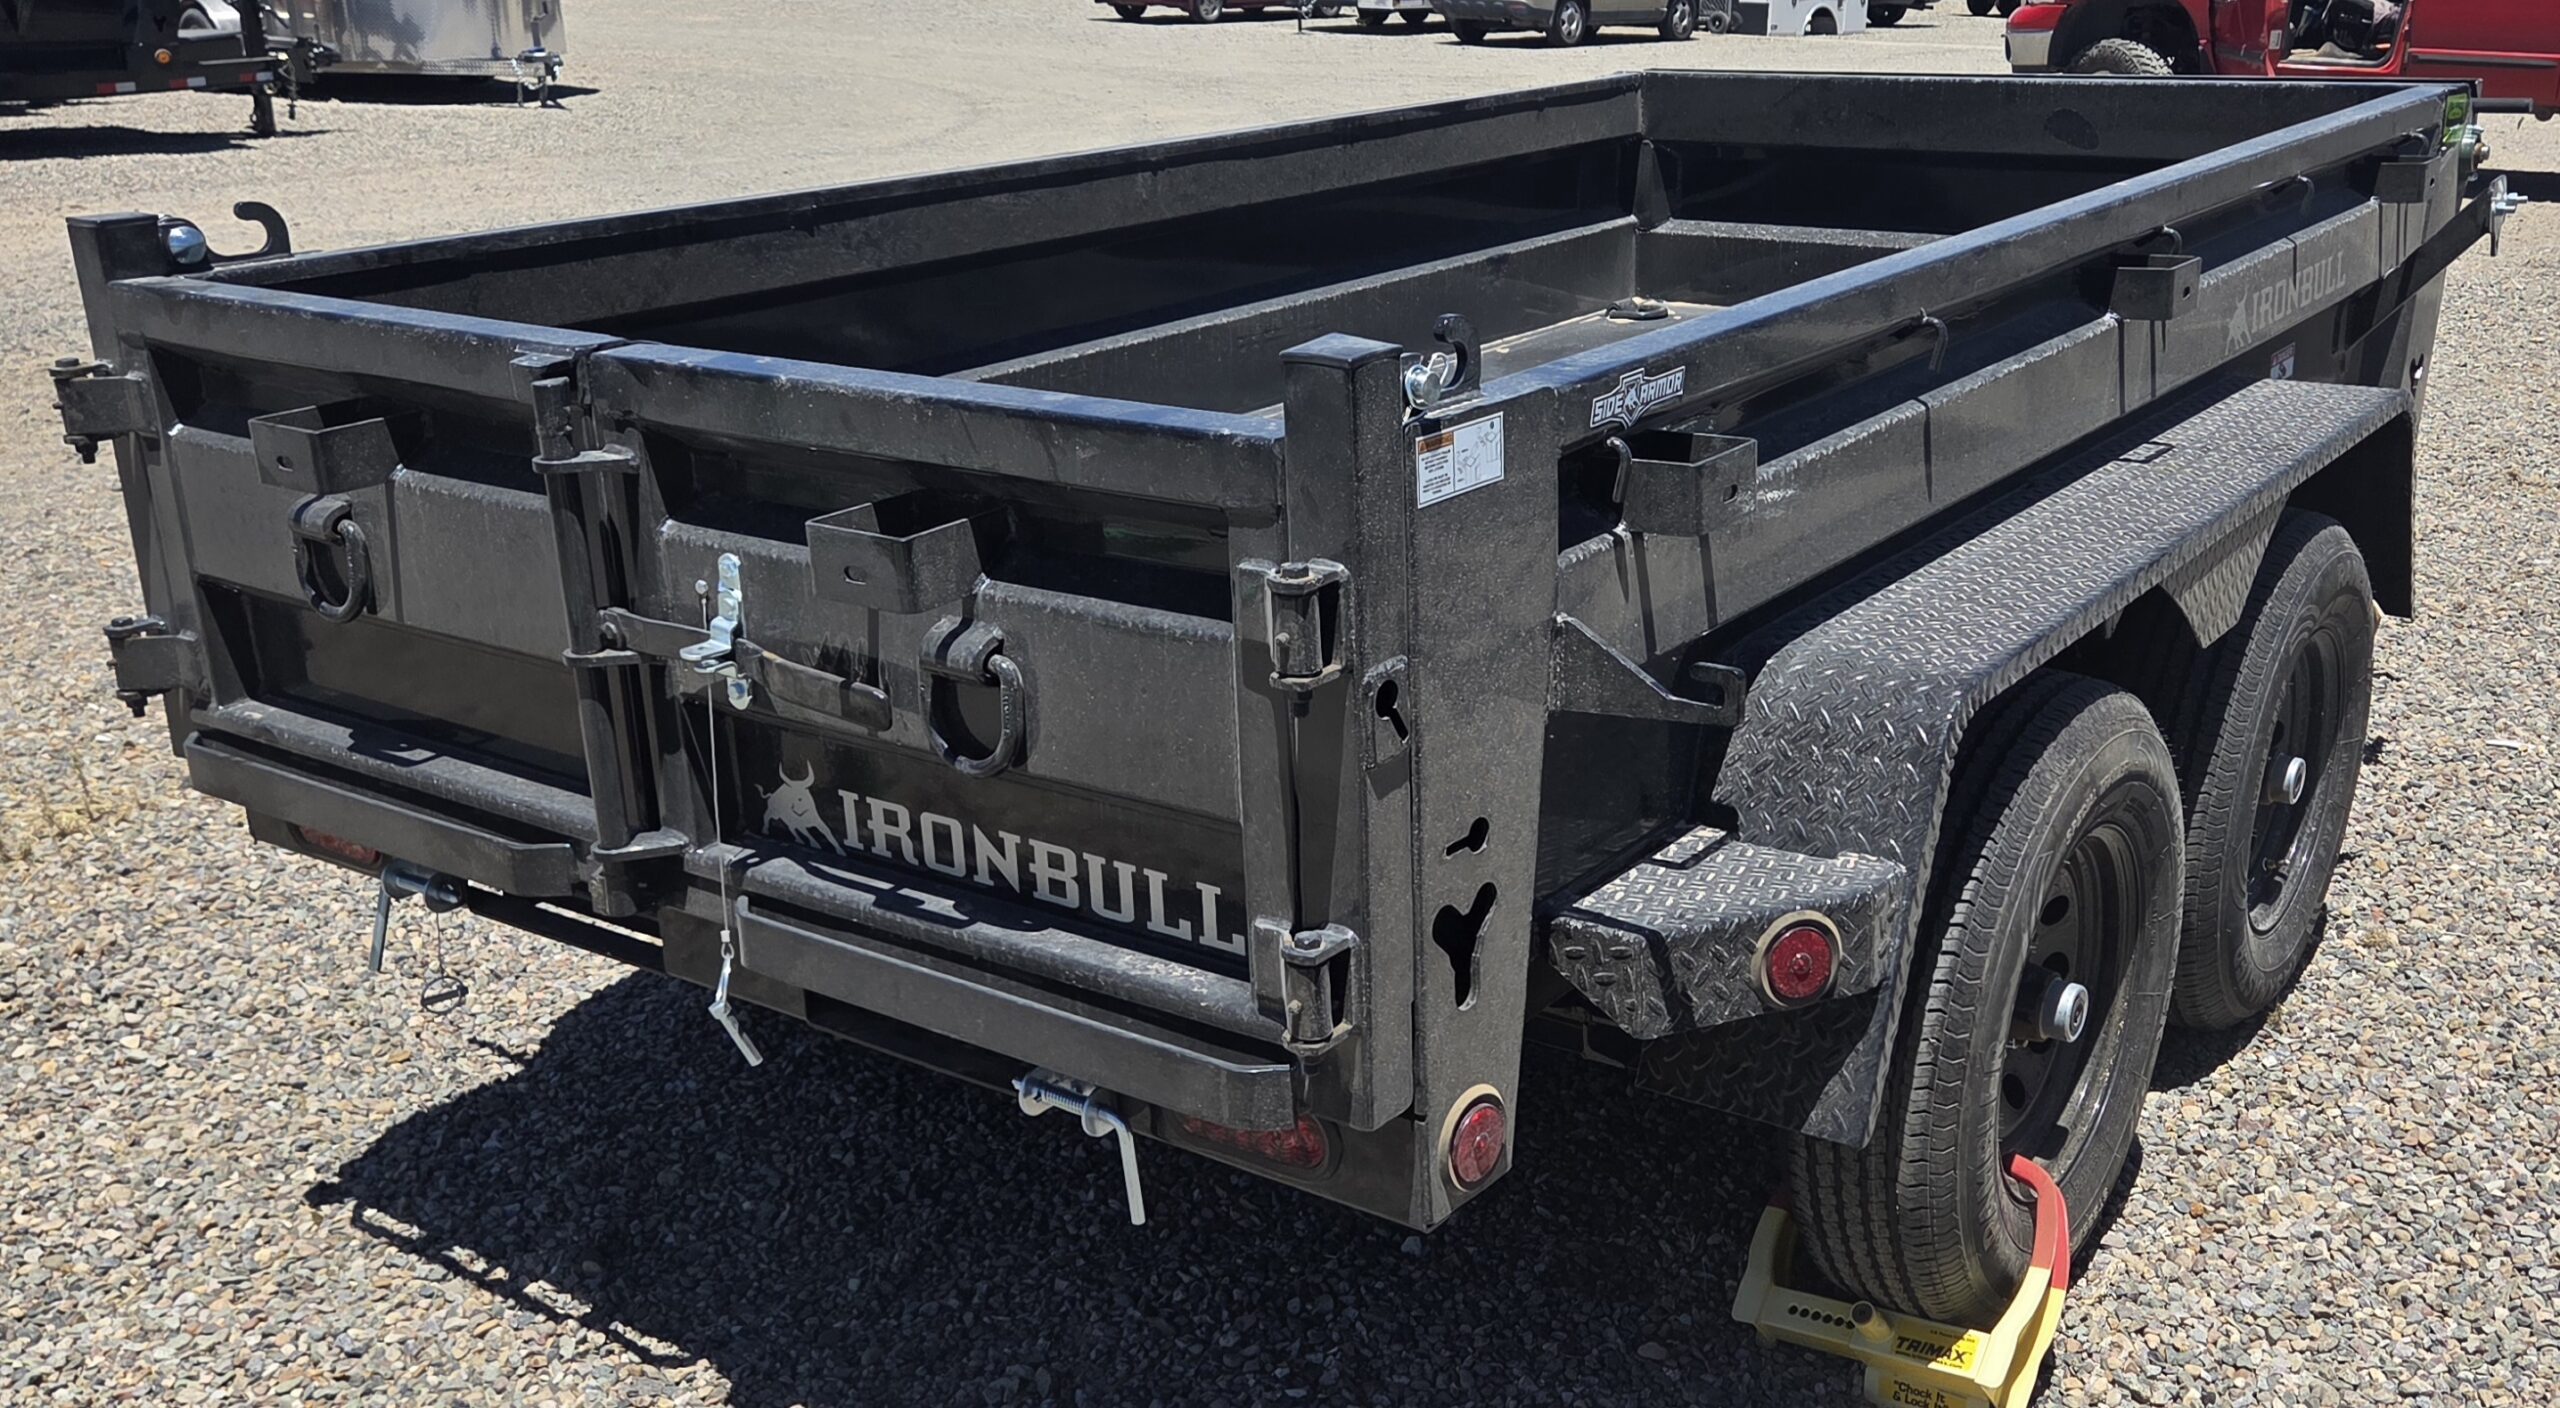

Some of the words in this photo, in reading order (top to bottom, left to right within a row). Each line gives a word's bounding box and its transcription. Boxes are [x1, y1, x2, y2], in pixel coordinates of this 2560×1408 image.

[2251, 250, 2347, 334] IRONBULL
[1593, 392, 1625, 423] SIDE
[1641, 371, 1684, 404] ARMOR
[838, 789, 1247, 957] IRONBULL
[1895, 1335, 1973, 1365] TRIMAX
